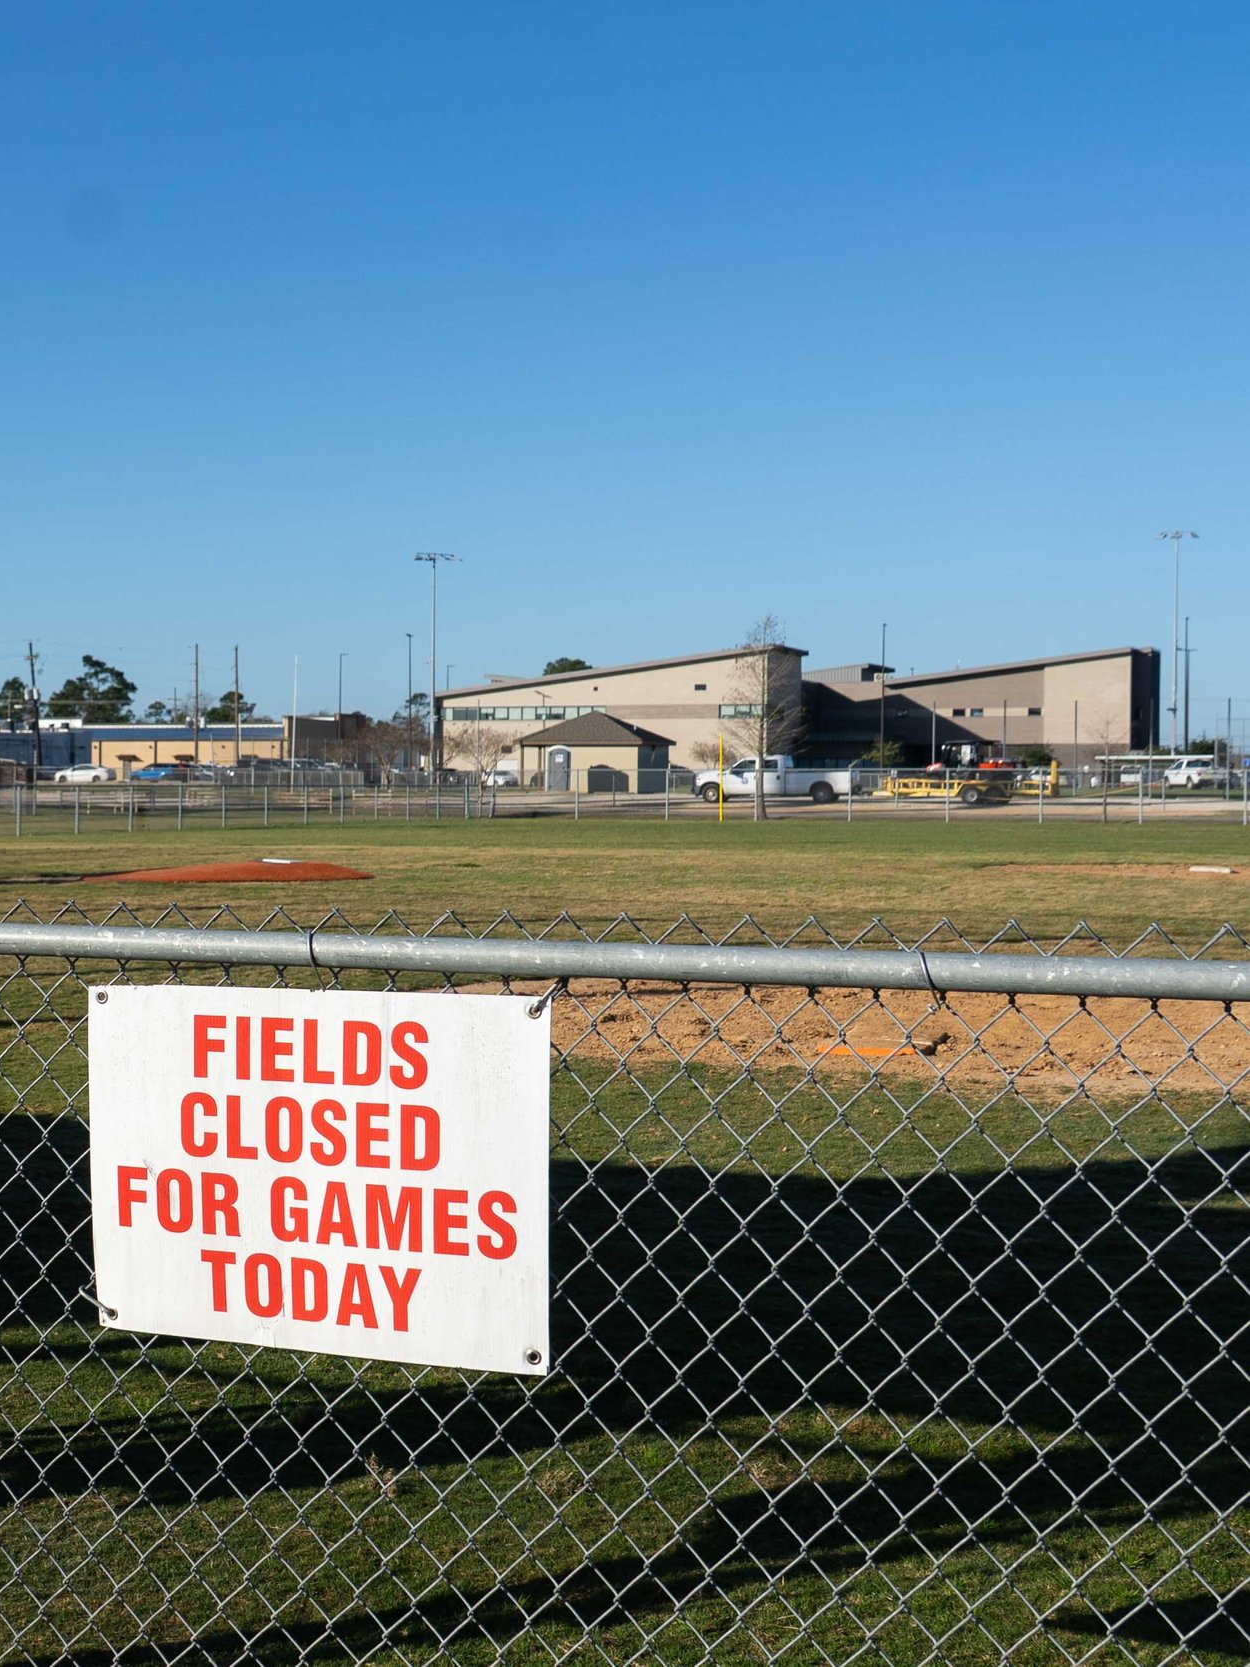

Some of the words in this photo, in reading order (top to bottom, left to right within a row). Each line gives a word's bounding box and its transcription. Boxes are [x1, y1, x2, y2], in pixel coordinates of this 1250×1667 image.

[194, 1015, 428, 1090] FIELDS
[181, 1092, 440, 1171] CLOSED
[118, 1166, 240, 1237] FOR
[270, 1176, 517, 1260] GAMES
[201, 1250, 421, 1332] TODAY
